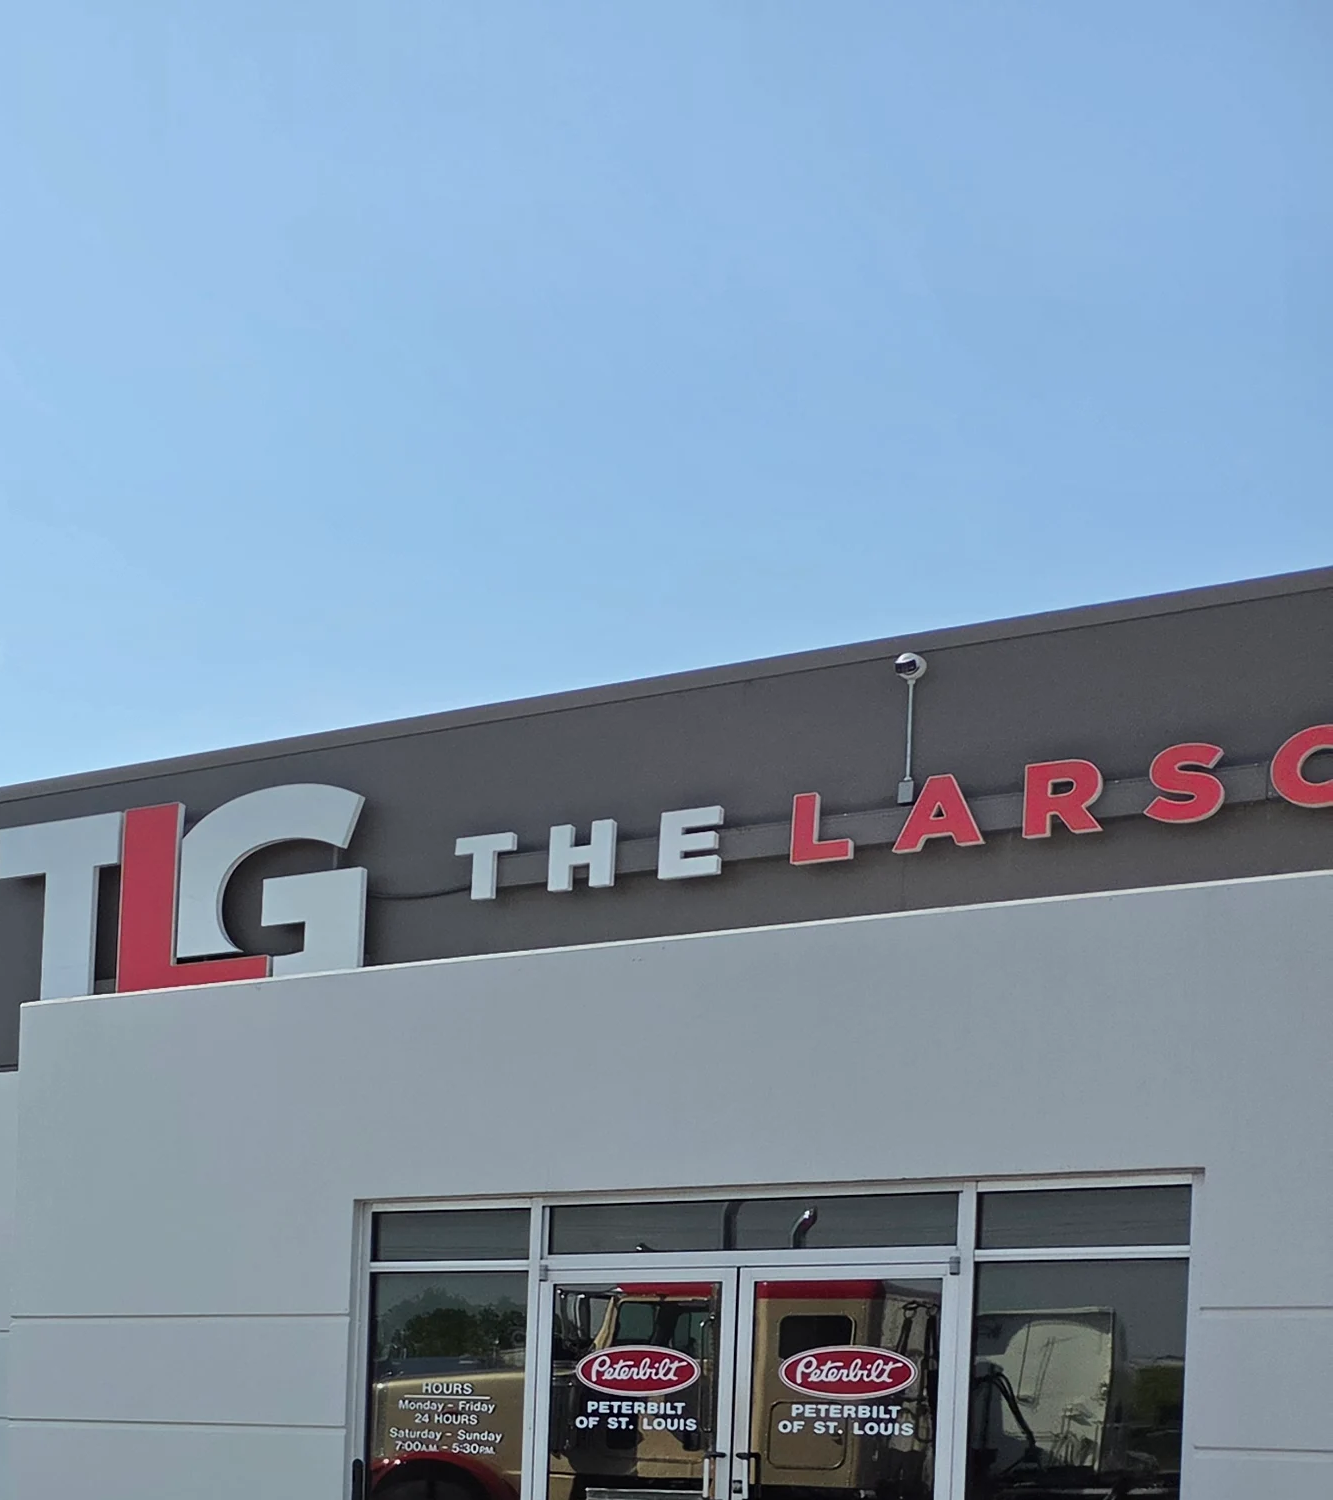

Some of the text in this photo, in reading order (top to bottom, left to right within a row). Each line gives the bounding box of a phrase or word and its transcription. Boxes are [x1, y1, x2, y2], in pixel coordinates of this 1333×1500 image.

[454, 805, 725, 900] THE
[591, 1355, 688, 1382] Peterbilt
[796, 1356, 904, 1384] Peterbilt
[422, 1383, 473, 1394] HOURS
[398, 1400, 444, 1412] Monday
[458, 1401, 495, 1413] Friday
[587, 1401, 686, 1415] PETERBILT
[791, 1404, 901, 1419] PETERBILT
[414, 1413, 478, 1425] 24 HOURS
[575, 1416, 697, 1431] OF ST. LOUIS
[389, 1427, 442, 1440] Saturday
[457, 1430, 503, 1442] Sunday
[778, 1420, 914, 1436] OF ST. LOUIS
